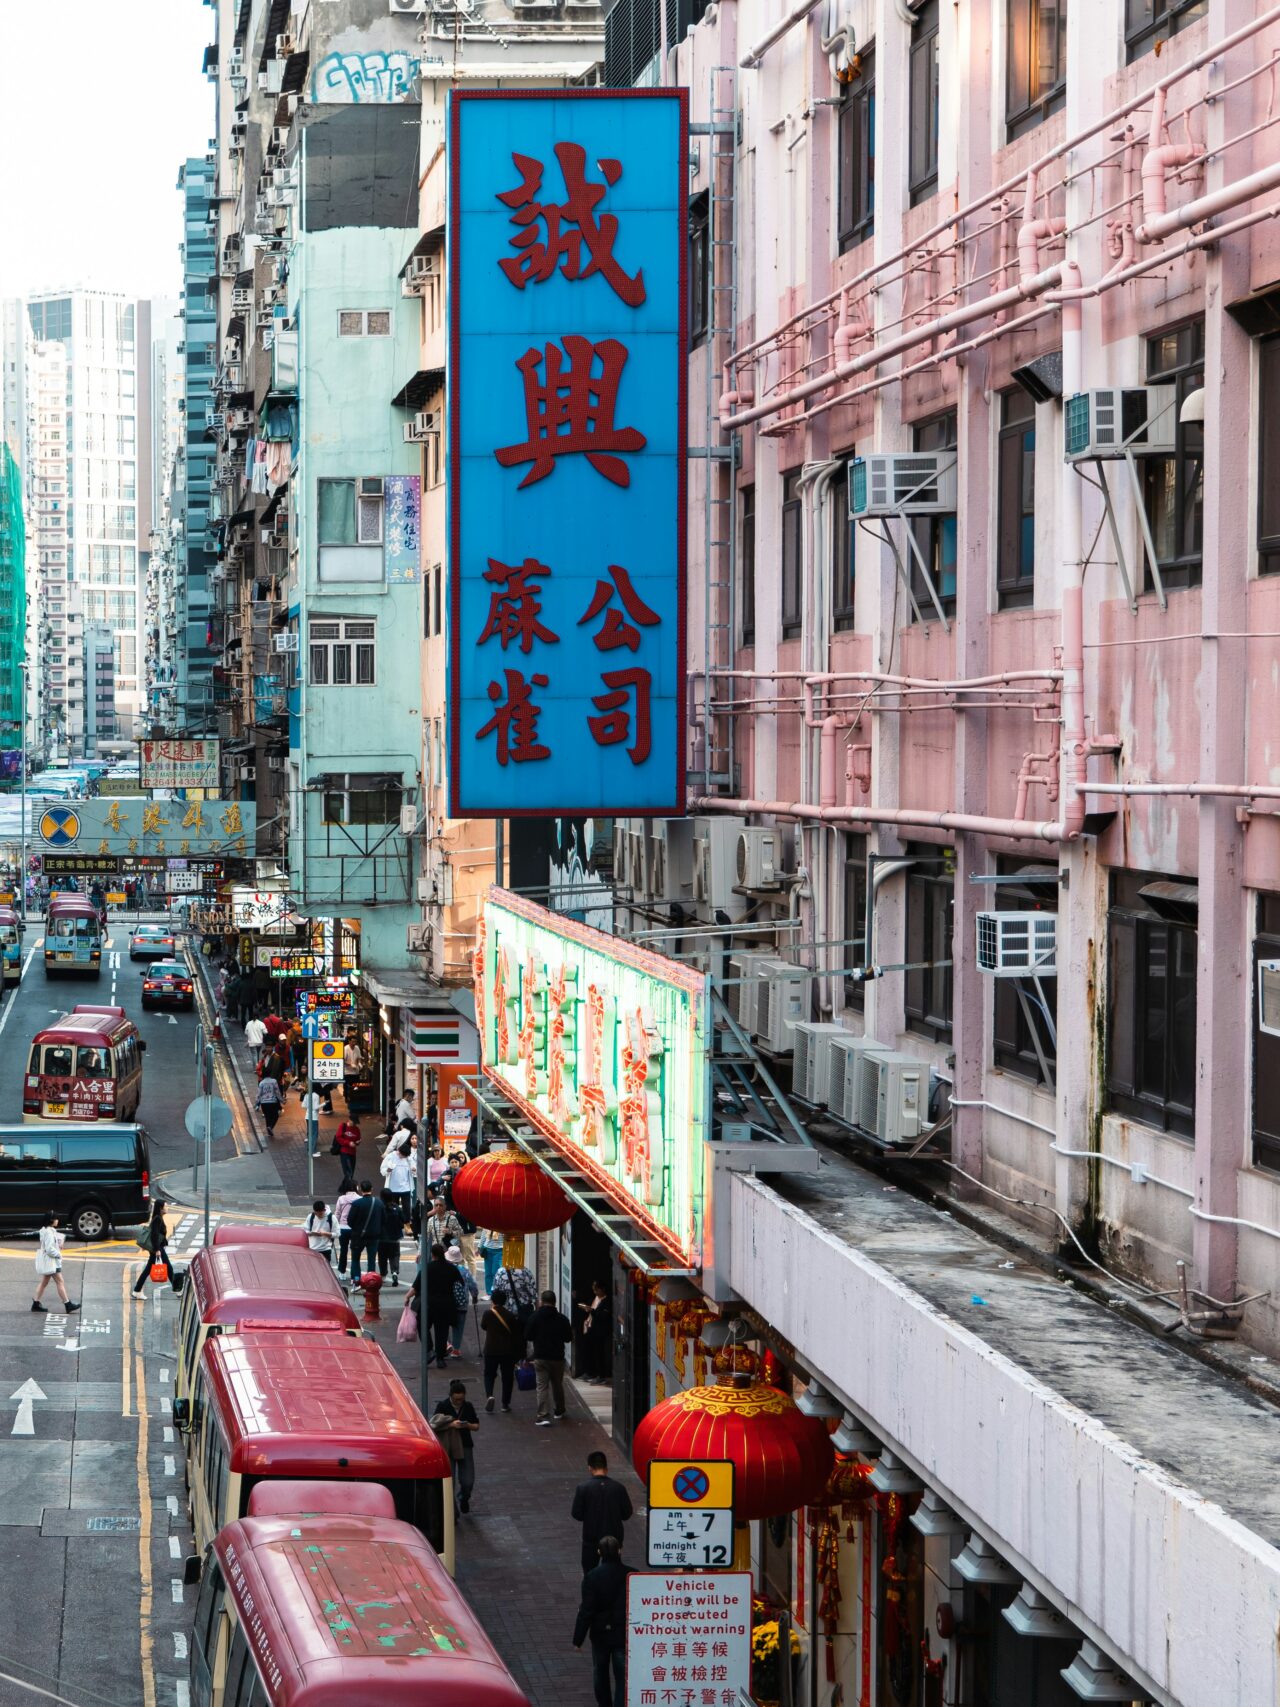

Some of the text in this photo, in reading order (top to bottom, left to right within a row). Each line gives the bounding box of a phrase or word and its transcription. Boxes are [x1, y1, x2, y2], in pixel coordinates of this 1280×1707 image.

[333, 993, 351, 1001] SPA
[320, 1069, 337, 1077] 全日
[73, 1080, 114, 1093] 八合里
[663, 1521, 687, 1532] 上午
[702, 1513, 715, 1532] 7
[653, 1542, 727, 1564] midnight 12
[662, 1552, 687, 1564] 午夜
[665, 1580, 715, 1591] Vehicle
[641, 1594, 738, 1606] waiting will be
[651, 1610, 728, 1622] prosecuted
[633, 1624, 745, 1636] without warning
[651, 1642, 728, 1658] 停車等候
[651, 1665, 728, 1682] 會被檢控
[640, 1689, 736, 1706] 而不予警告
